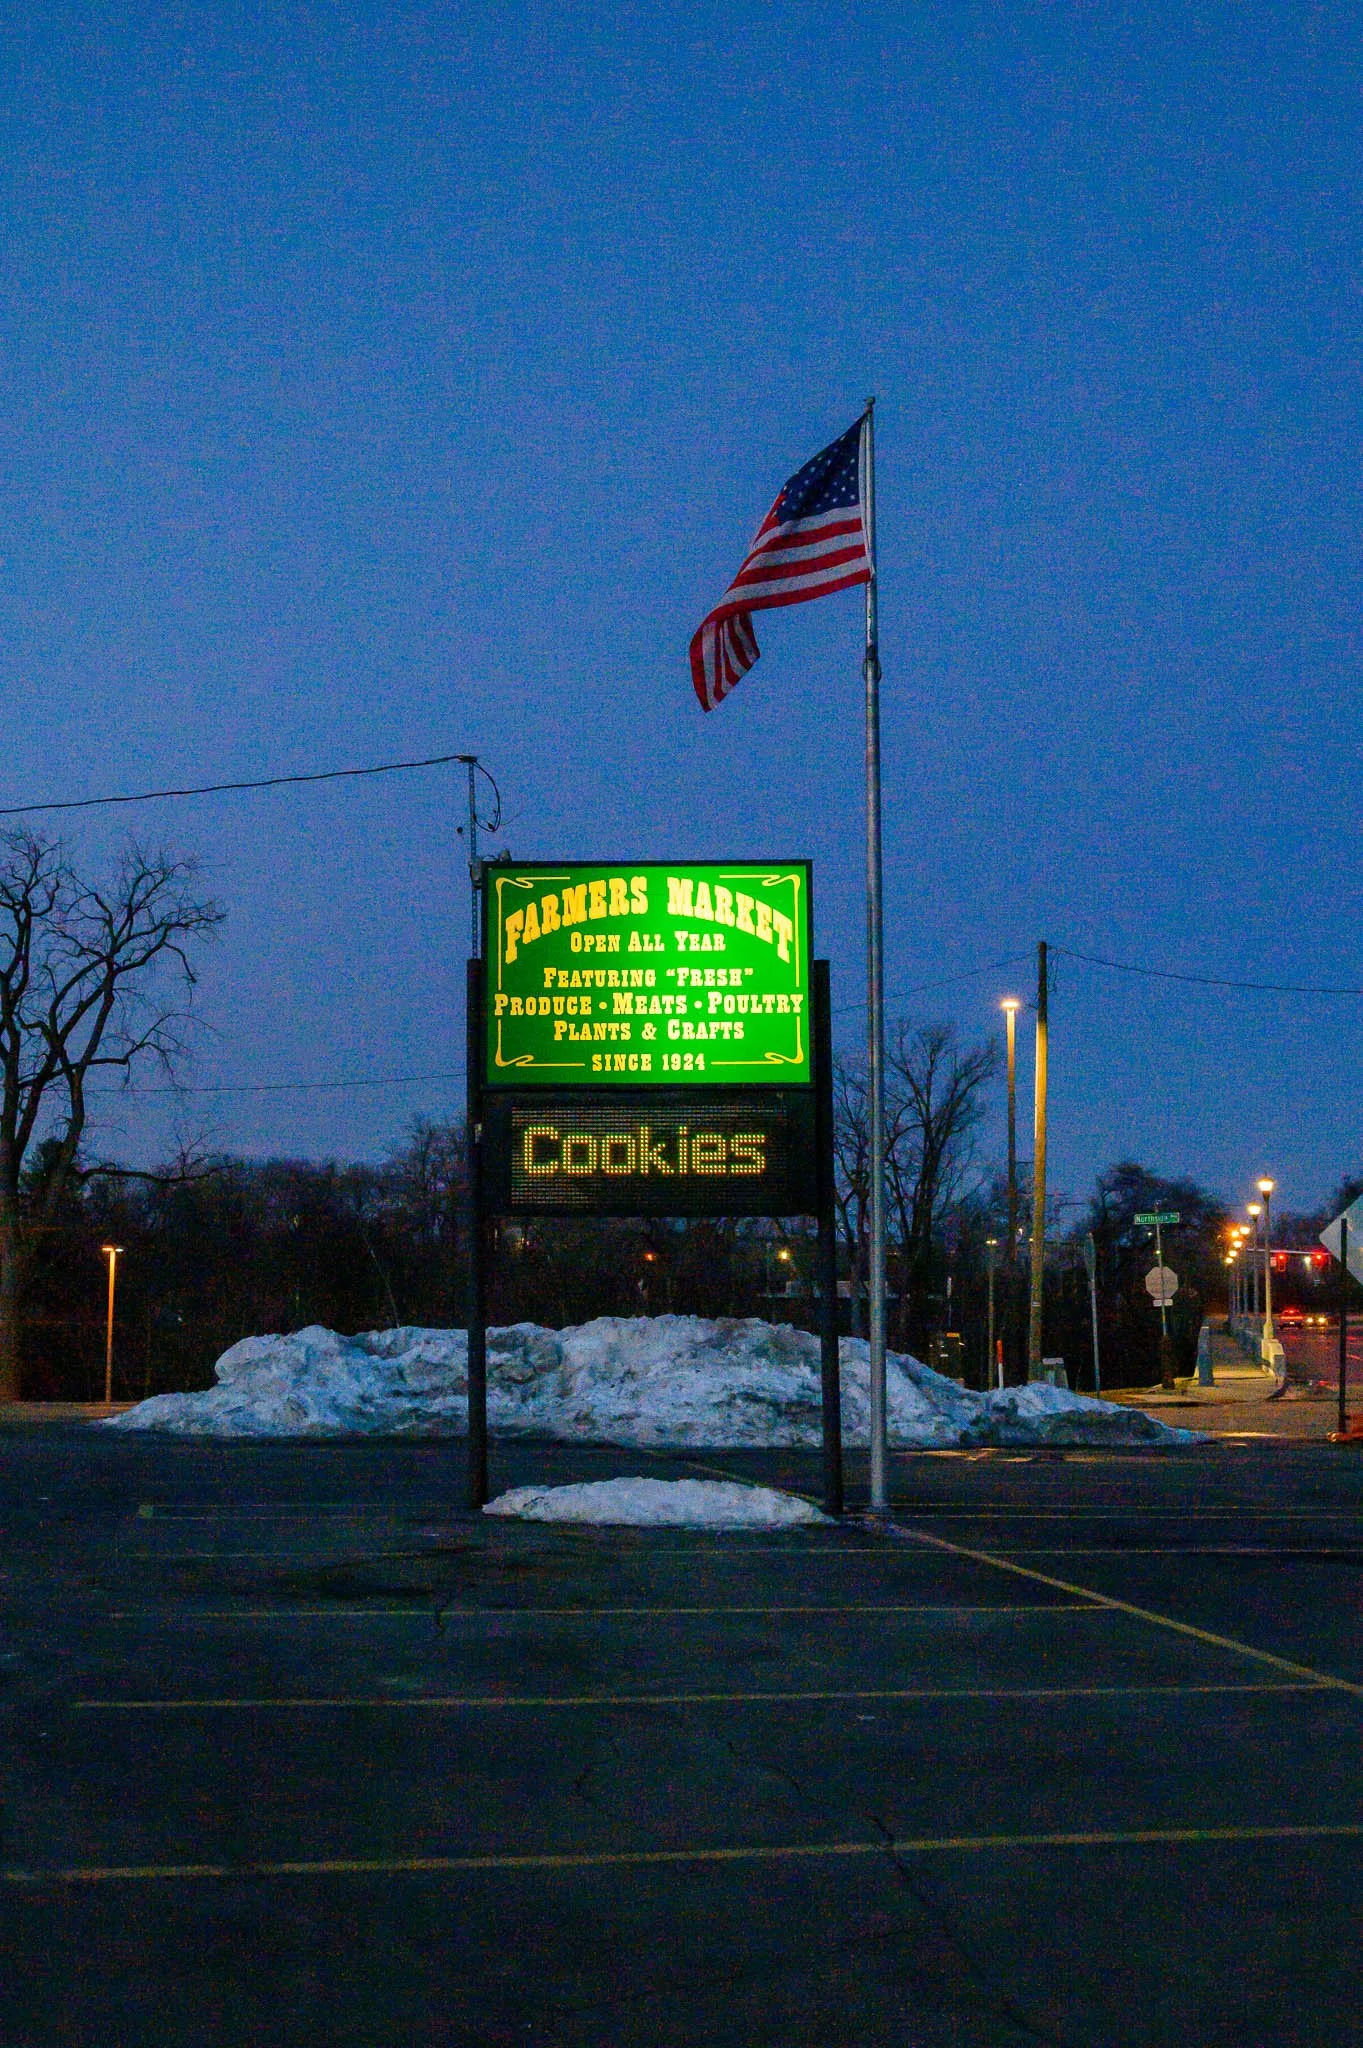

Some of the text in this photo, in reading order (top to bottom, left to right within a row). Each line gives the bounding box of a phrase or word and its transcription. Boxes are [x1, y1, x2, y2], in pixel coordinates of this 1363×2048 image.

[504, 876, 792, 964] FARMERS MARKET
[570, 931, 726, 952] OPEN ALL YEAR
[544, 967, 656, 987] FEATURING
[495, 992, 803, 1015] PRODUCE MEATS POULTRY
[554, 1019, 744, 1040] PLANTS & CRAFTS
[592, 1053, 705, 1071] SINCE 1924
[524, 1126, 766, 1174] Cookies
